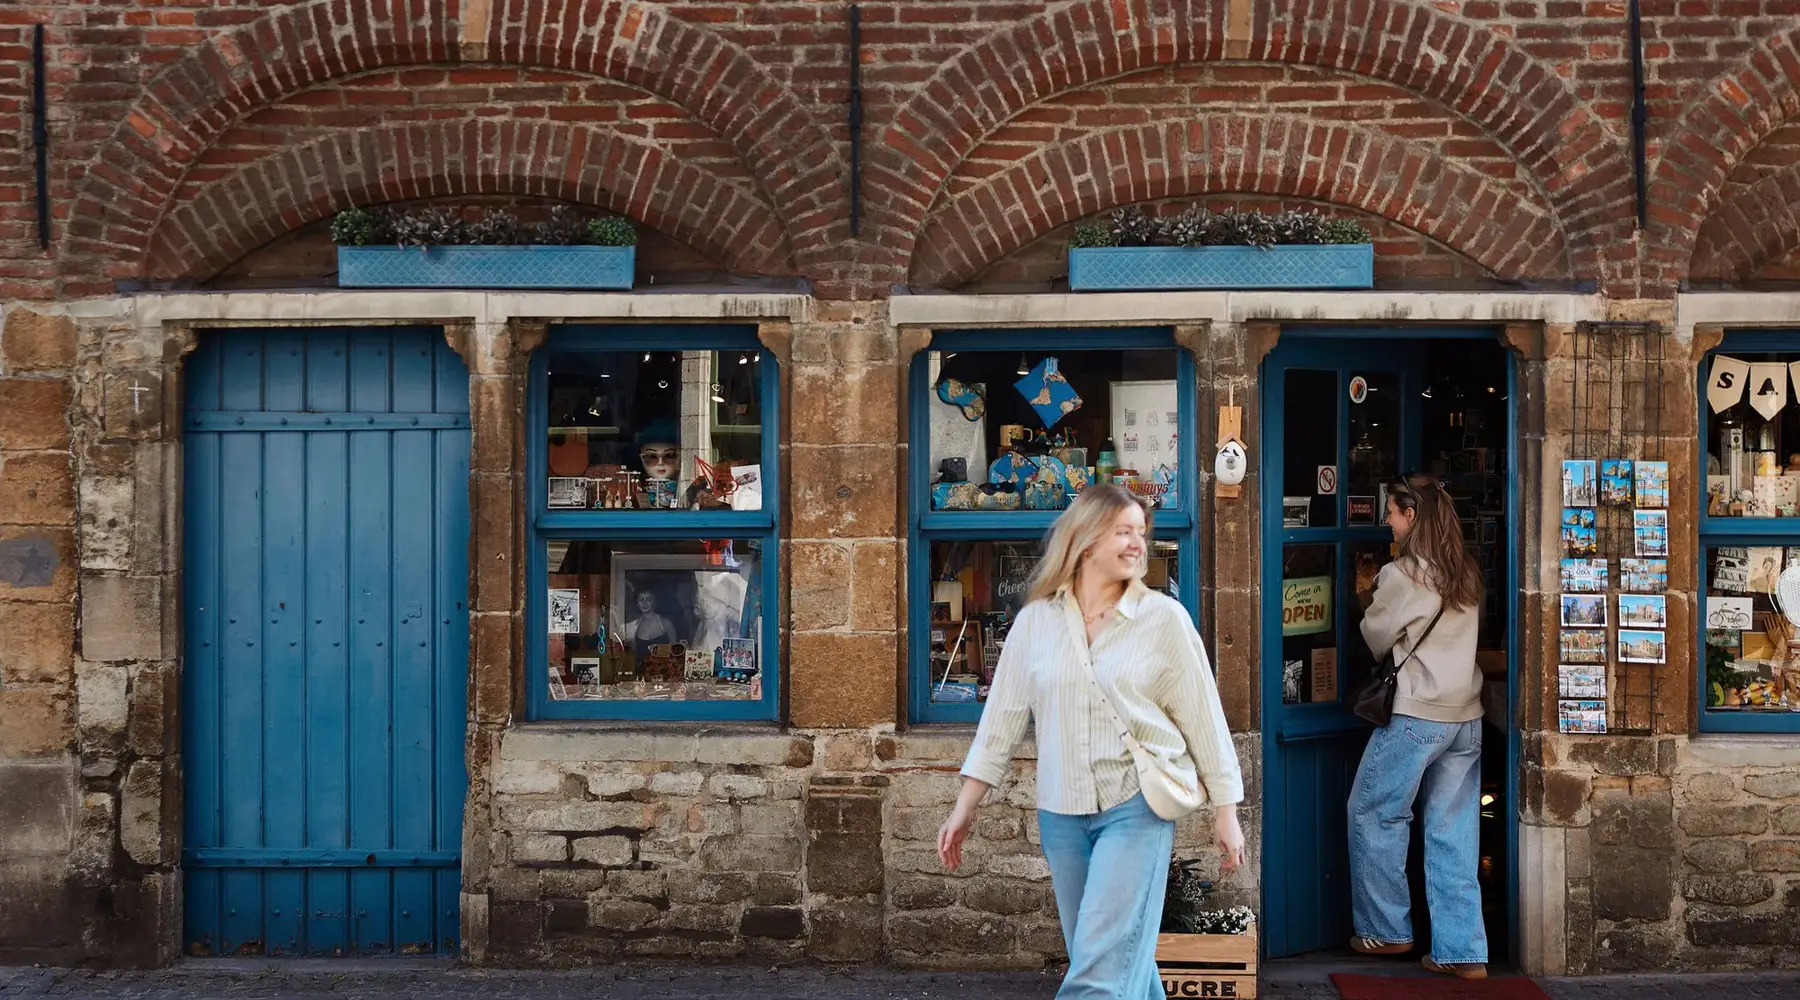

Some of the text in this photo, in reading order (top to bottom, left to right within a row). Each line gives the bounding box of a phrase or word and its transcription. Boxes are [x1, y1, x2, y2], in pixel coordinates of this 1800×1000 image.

[998, 580, 1027, 597] Cheer
[1285, 584, 1311, 601] Come
[1283, 604, 1324, 624] OPEN
[1162, 981, 1236, 996] UCRE
